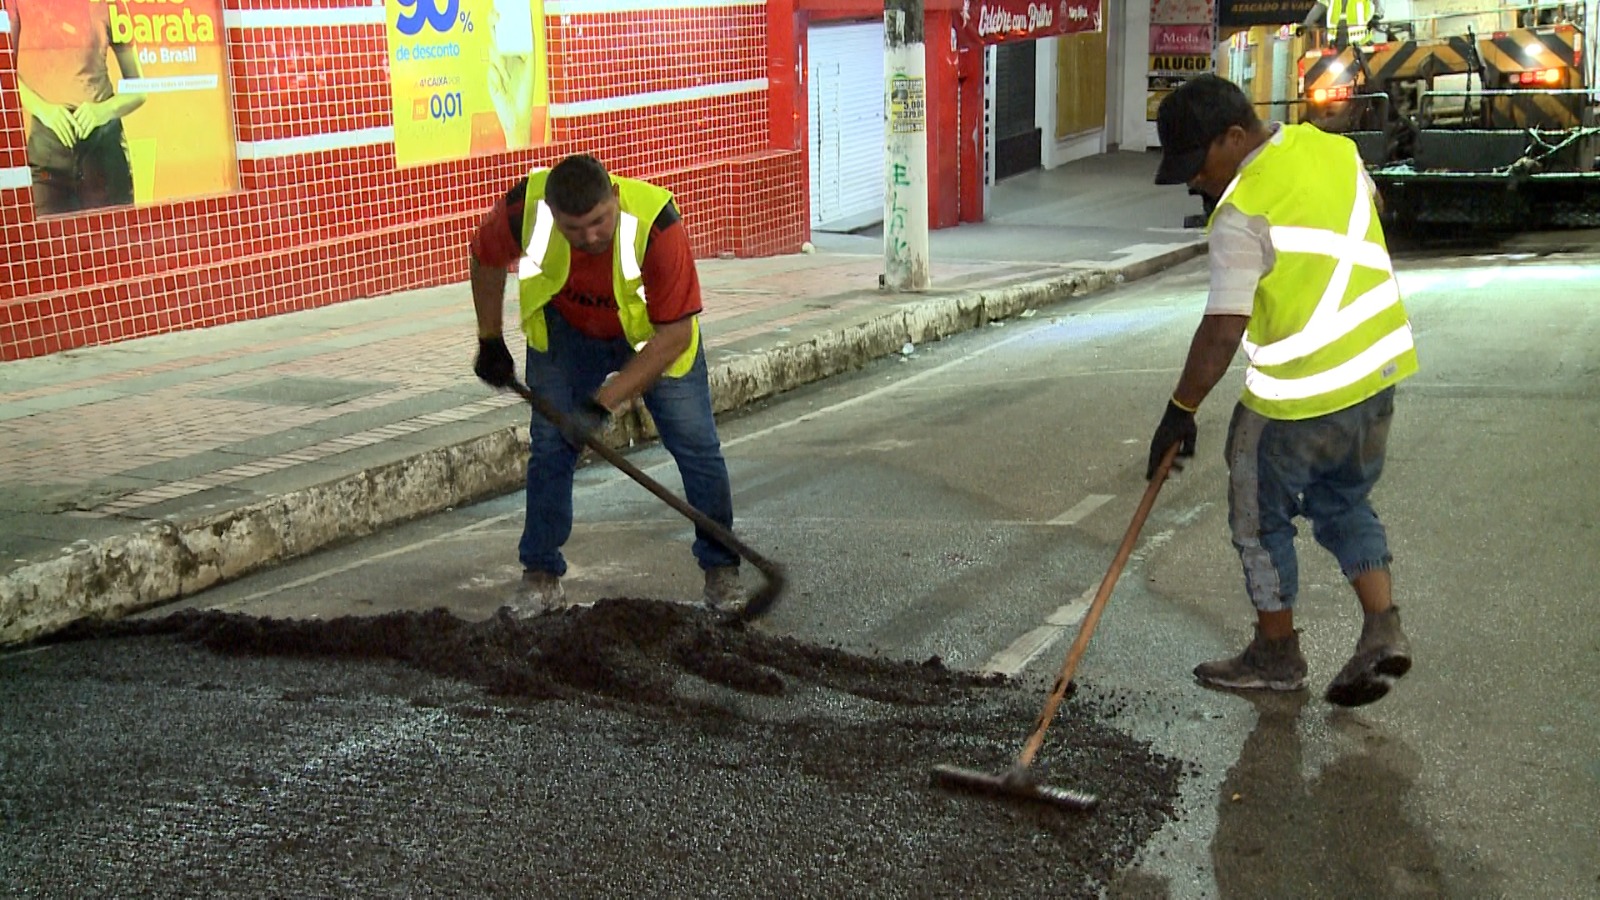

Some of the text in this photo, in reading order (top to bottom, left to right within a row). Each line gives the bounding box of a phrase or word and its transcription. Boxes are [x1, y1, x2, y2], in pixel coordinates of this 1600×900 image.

[1231, 3, 1279, 12] ATACADO
[1282, 2, 1289, 10] E
[109, 4, 215, 43] barata
[978, 5, 1012, 37] Celebre
[1012, 14, 1027, 31] com
[1163, 32, 1200, 43] Moda
[139, 46, 197, 64] do Brasil
[396, 42, 461, 61] de desconto
[1153, 57, 1207, 70] ALUGO
[427, 76, 448, 87] CAIXA
[430, 92, 463, 124] 0,01
